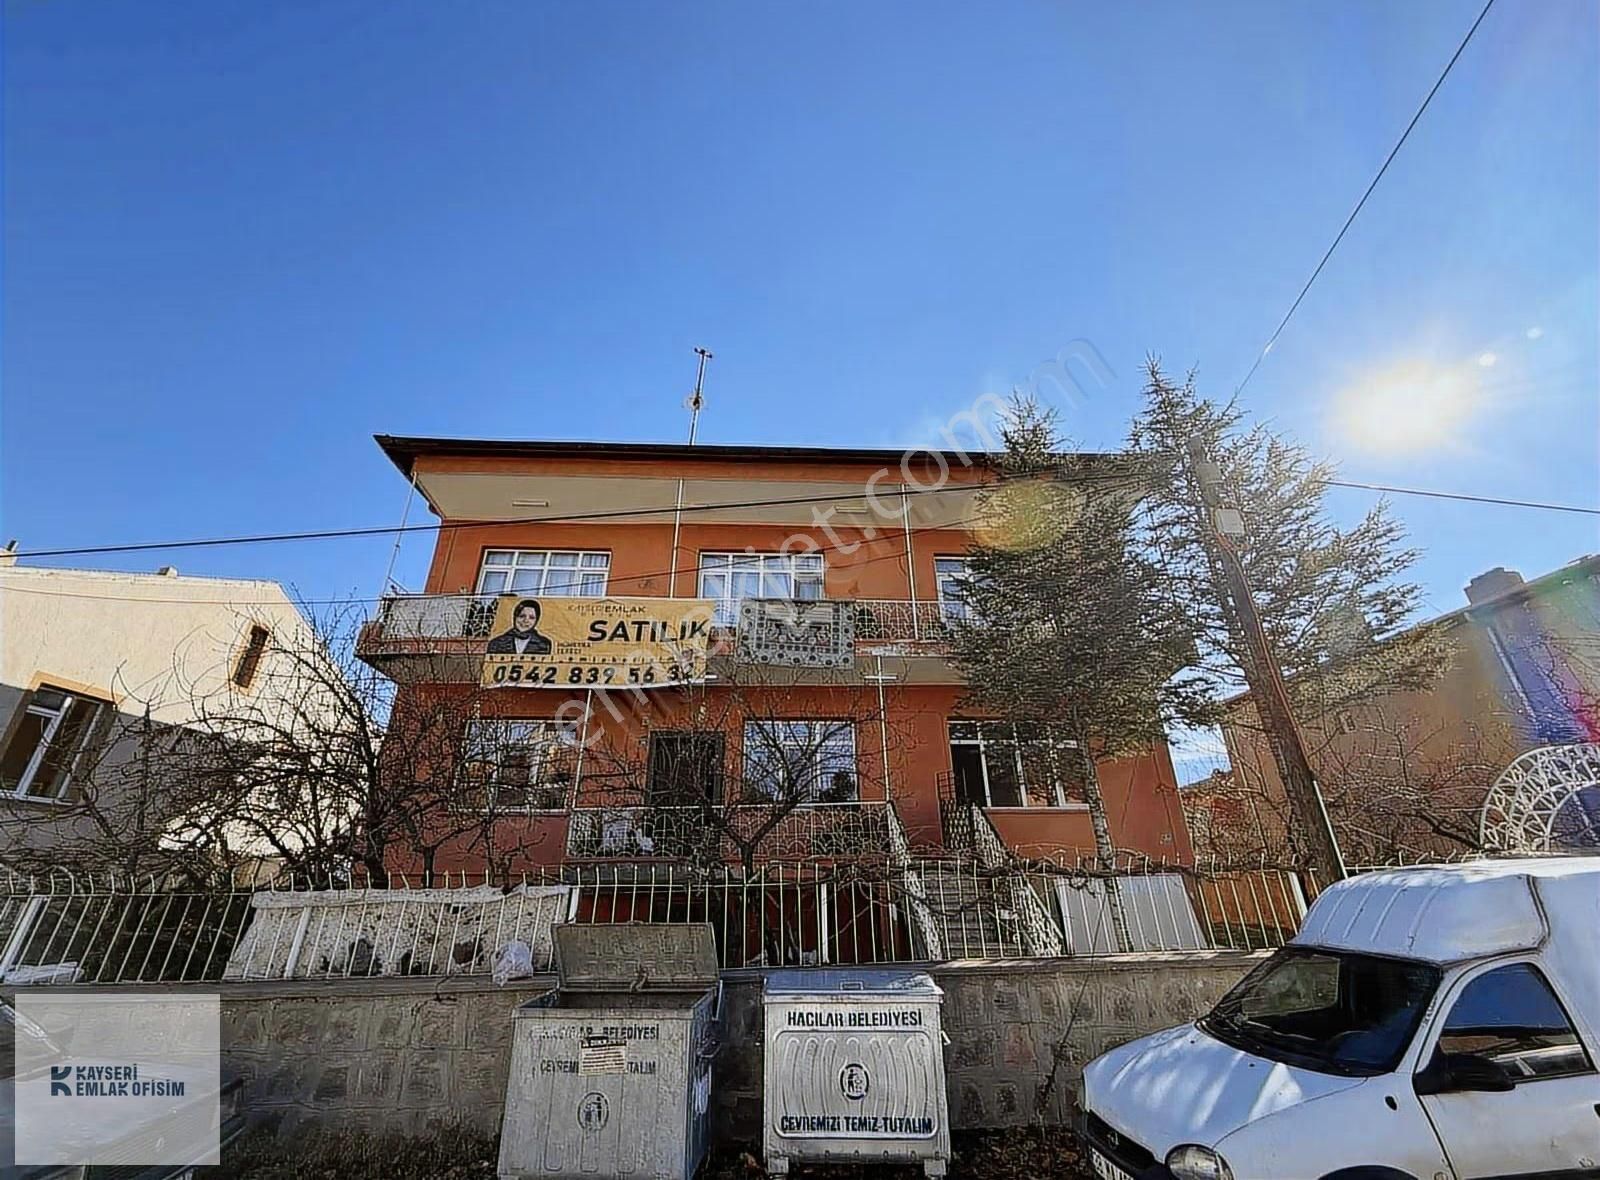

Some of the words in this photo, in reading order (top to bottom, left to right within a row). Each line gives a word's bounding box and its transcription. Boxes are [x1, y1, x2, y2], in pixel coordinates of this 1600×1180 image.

[587, 618, 710, 643] SATILIK
[493, 665, 557, 684] 0542
[568, 667, 616, 684] 839
[628, 666, 655, 684] 56
[787, 1011, 844, 1027] HACILAR
[849, 1008, 923, 1027] BELEDİYESİ
